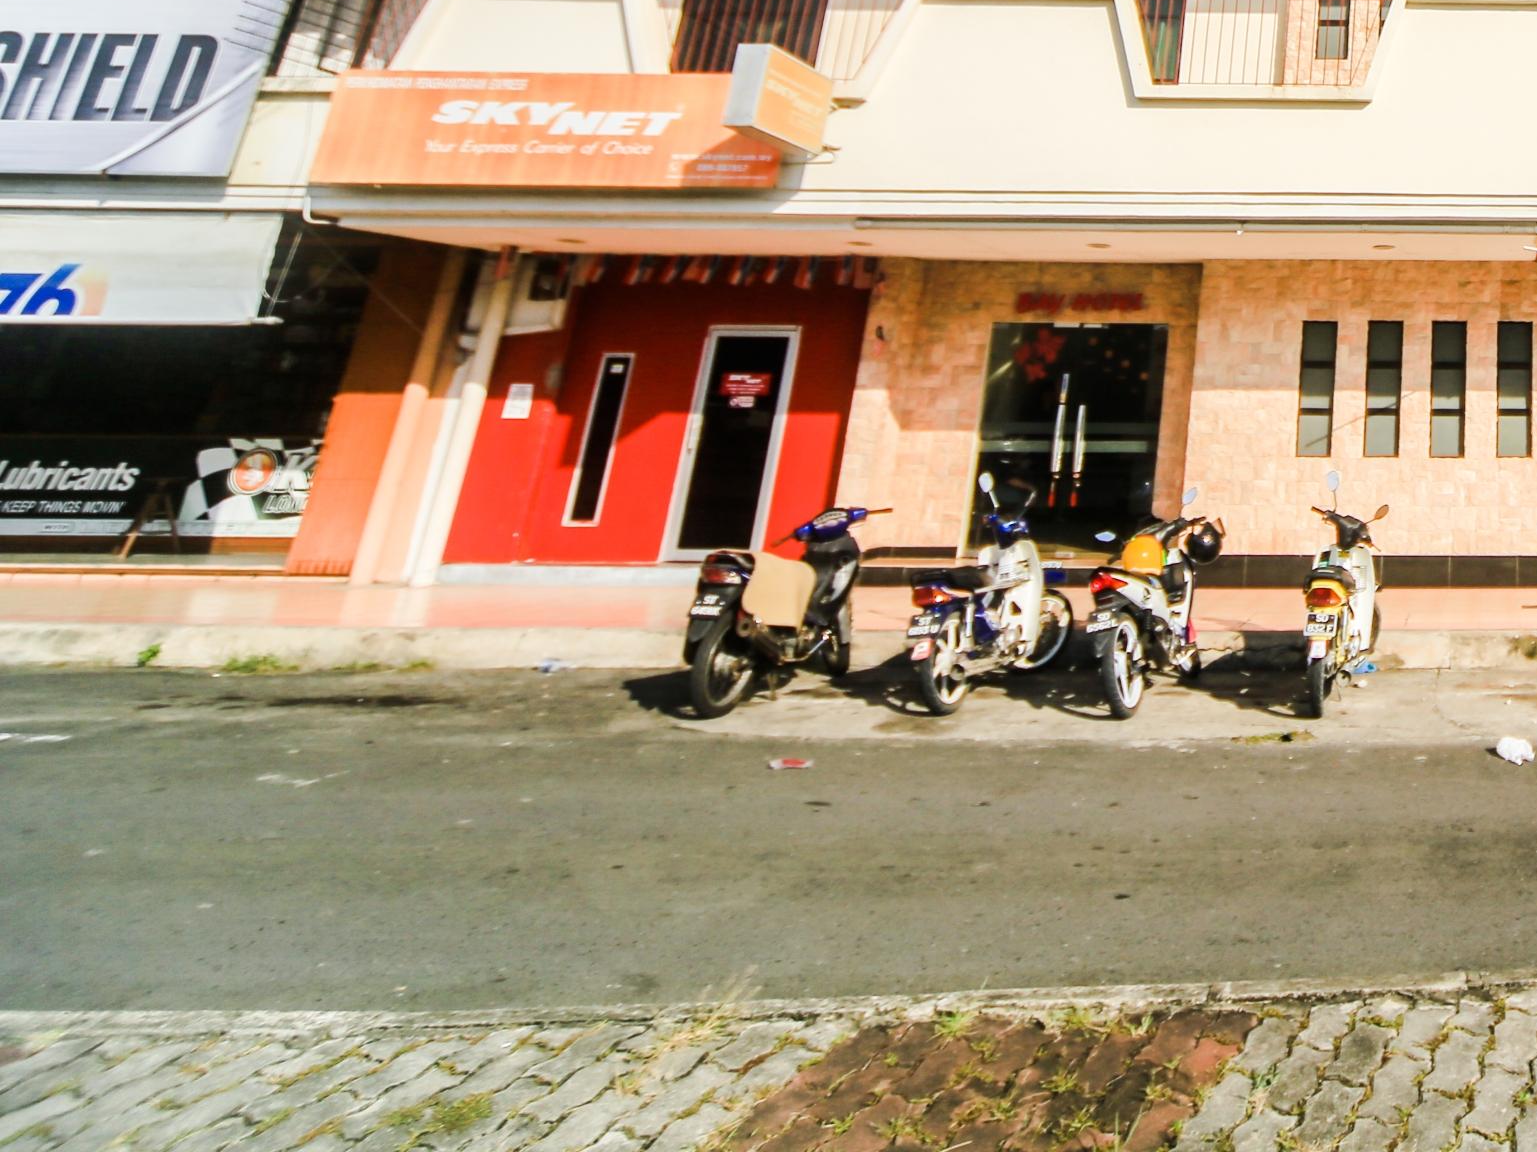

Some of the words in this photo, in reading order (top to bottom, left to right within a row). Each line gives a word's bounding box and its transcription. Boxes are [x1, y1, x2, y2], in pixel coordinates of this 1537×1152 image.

[431, 100, 681, 136] SKYNET
[425, 139, 457, 154] Your
[460, 139, 518, 155] Express
[580, 141, 597, 156] of
[602, 140, 655, 156] Choice
[2, 500, 37, 513] KEEP
[38, 500, 82, 514] THINGS
